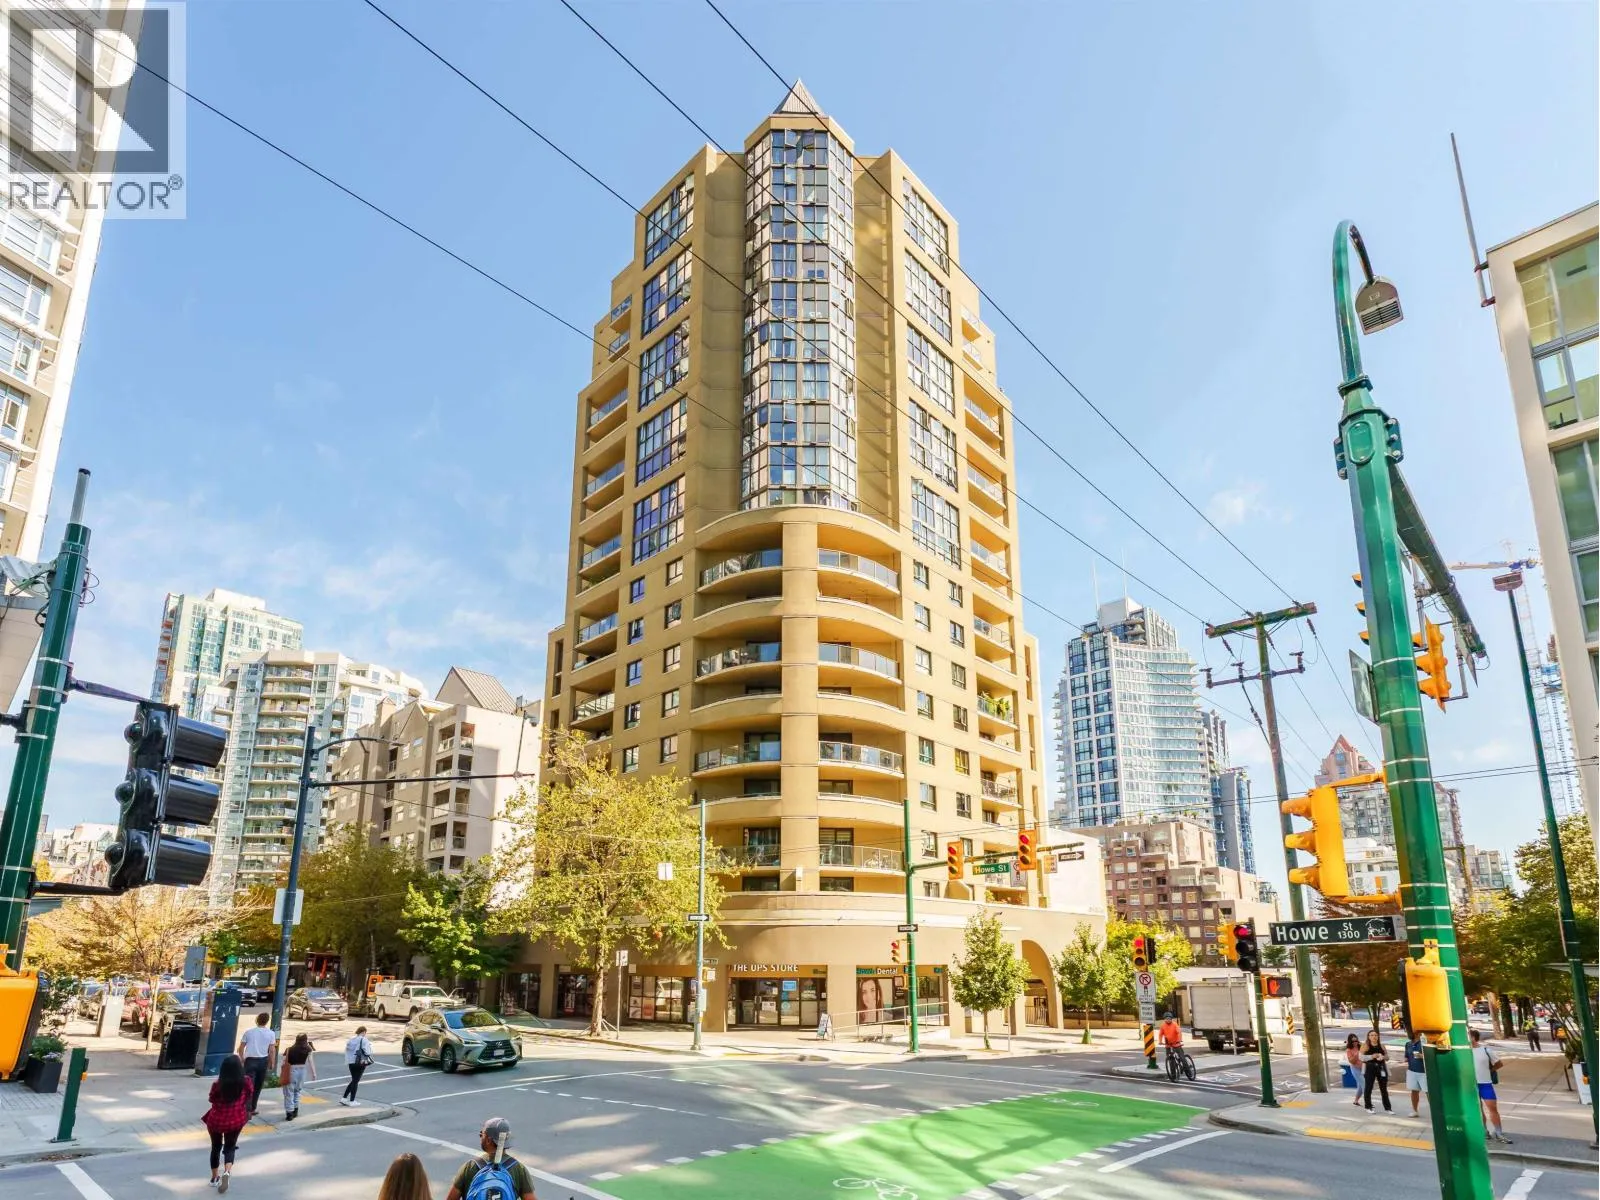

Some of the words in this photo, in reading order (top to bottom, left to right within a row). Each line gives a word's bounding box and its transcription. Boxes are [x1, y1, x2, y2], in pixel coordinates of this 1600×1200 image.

[975, 865, 995, 874] Howe
[998, 864, 1007, 872] St
[1275, 926, 1329, 942] Howe
[1342, 922, 1353, 931] St
[1337, 930, 1360, 939] 1300
[733, 963, 748, 972] THE
[751, 963, 768, 972] UPS
[771, 963, 799, 972] STORE
[877, 967, 898, 975] Dental
